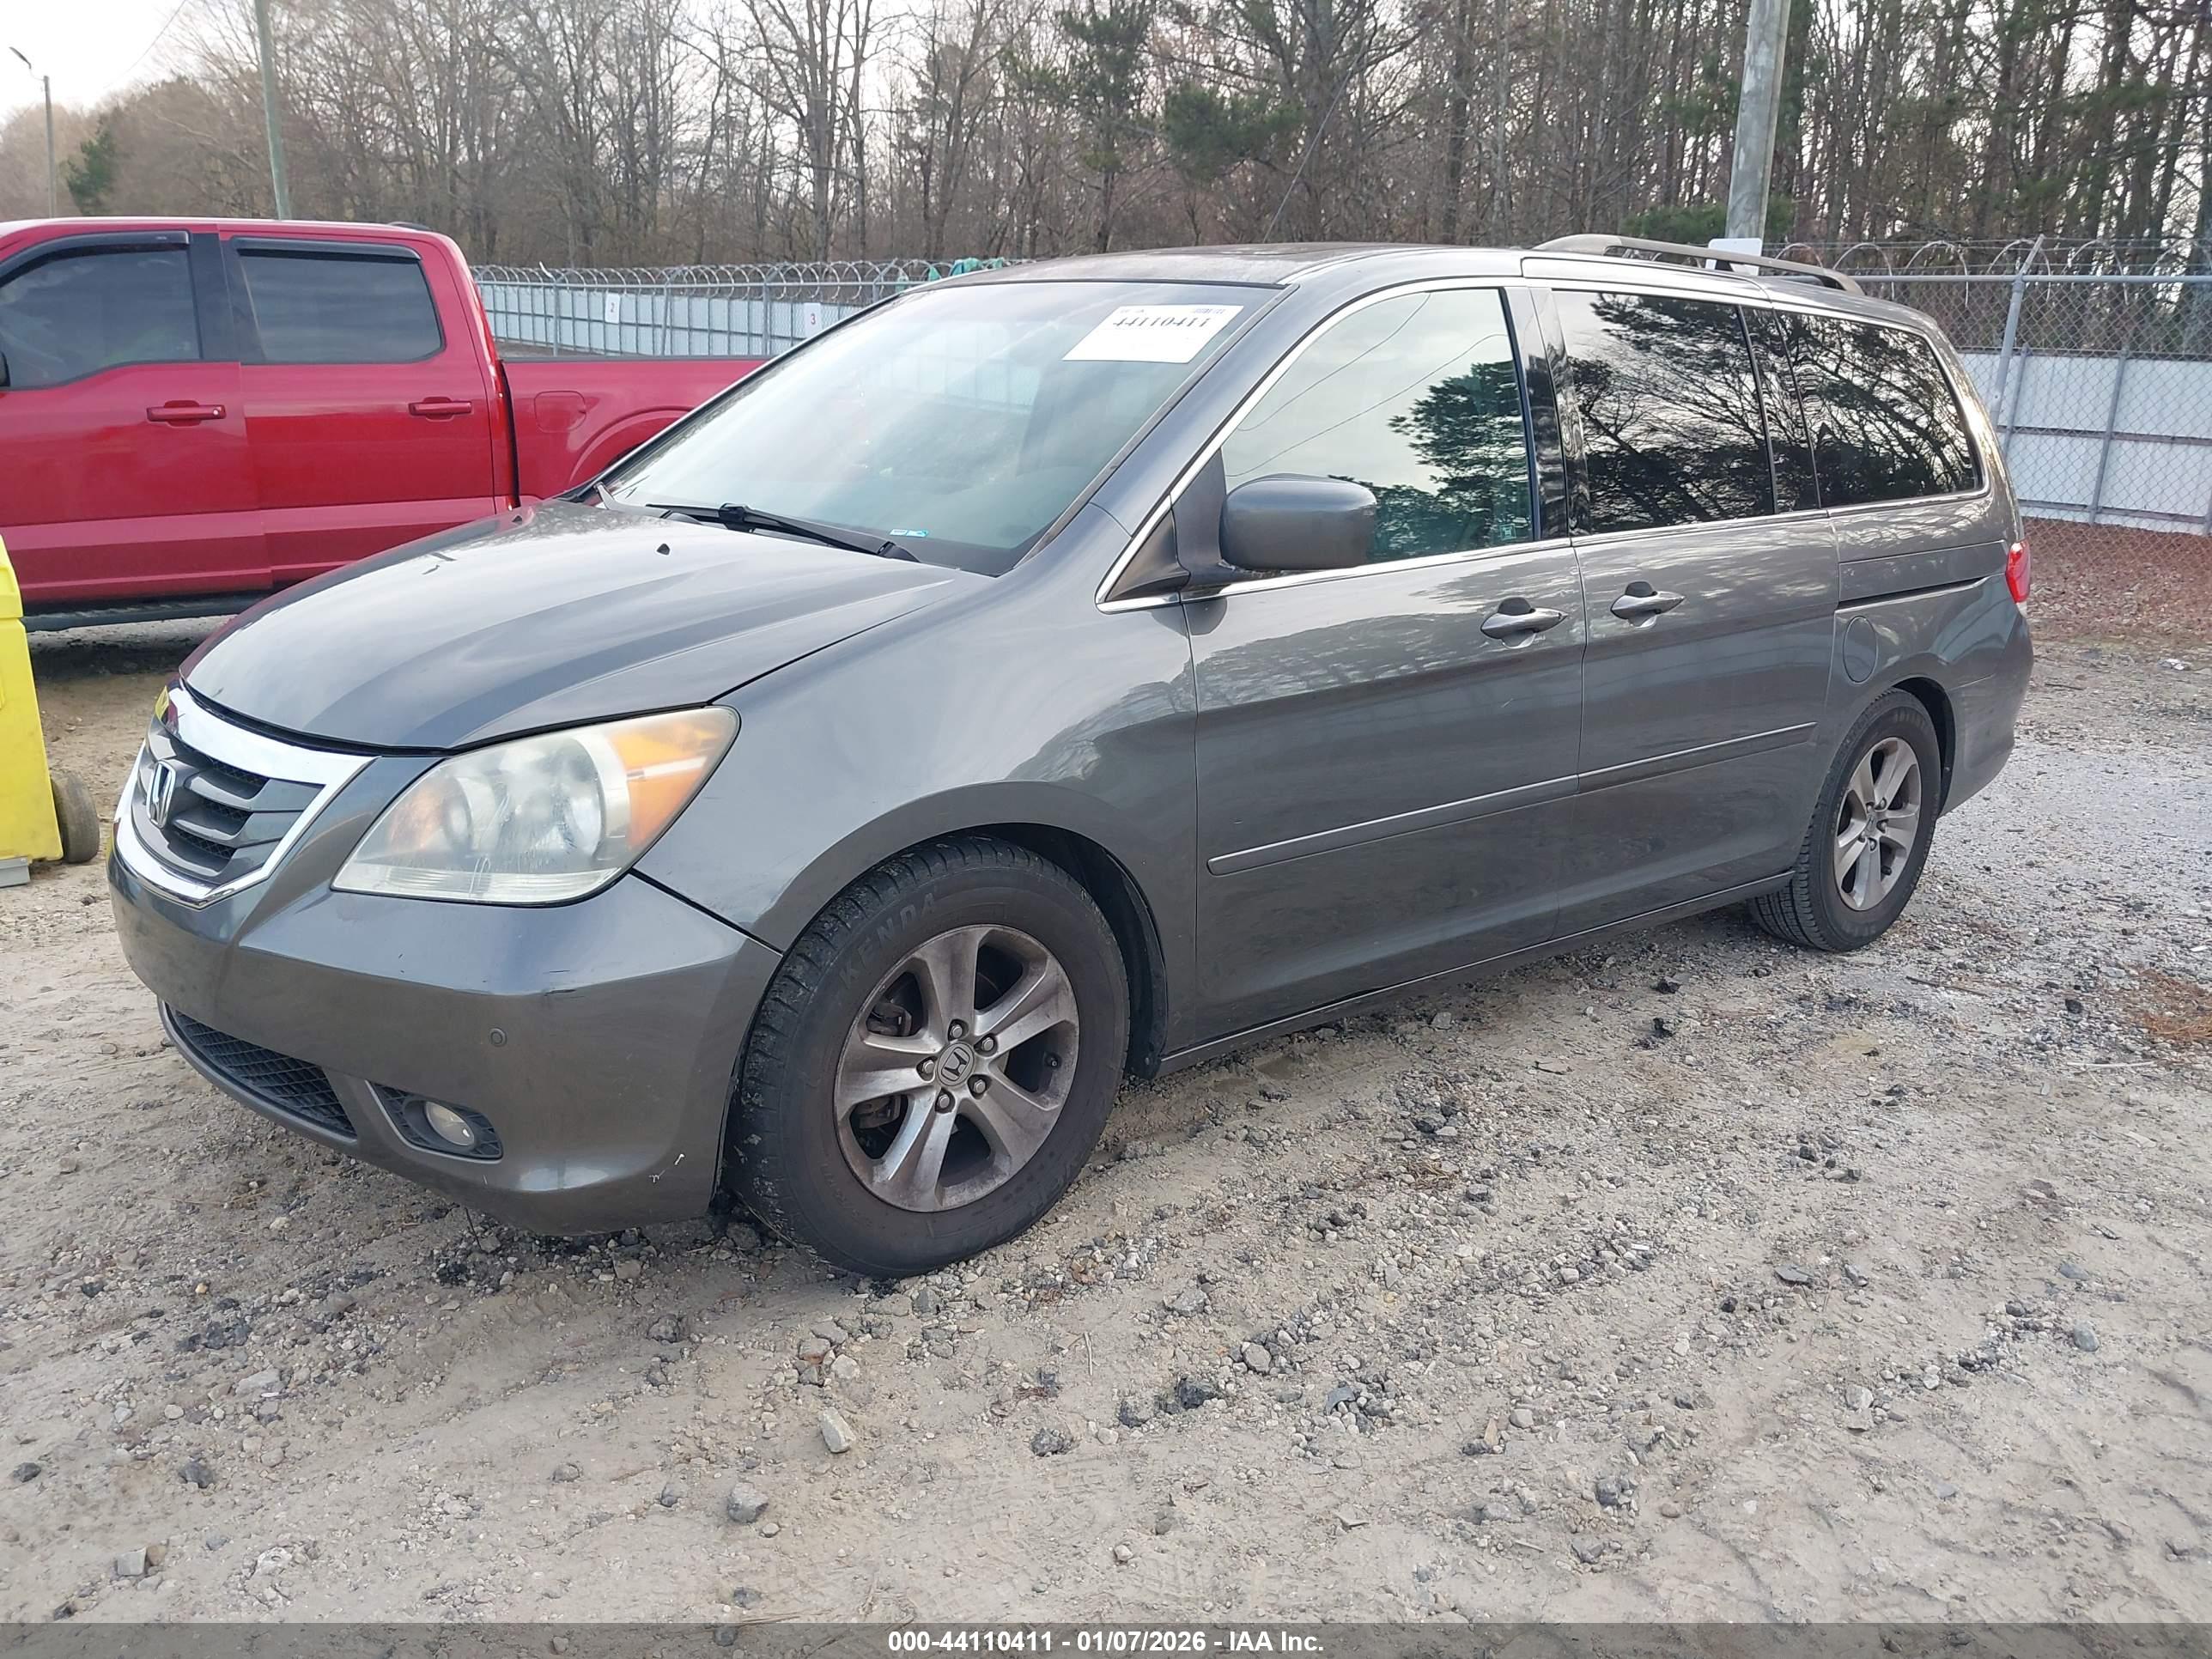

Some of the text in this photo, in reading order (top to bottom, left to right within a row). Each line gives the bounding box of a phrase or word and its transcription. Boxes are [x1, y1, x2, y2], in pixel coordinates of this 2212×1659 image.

[810, 313, 816, 325] 3
[1112, 317, 1212, 327] 44110411
[839, 892, 935, 990] KENDA
